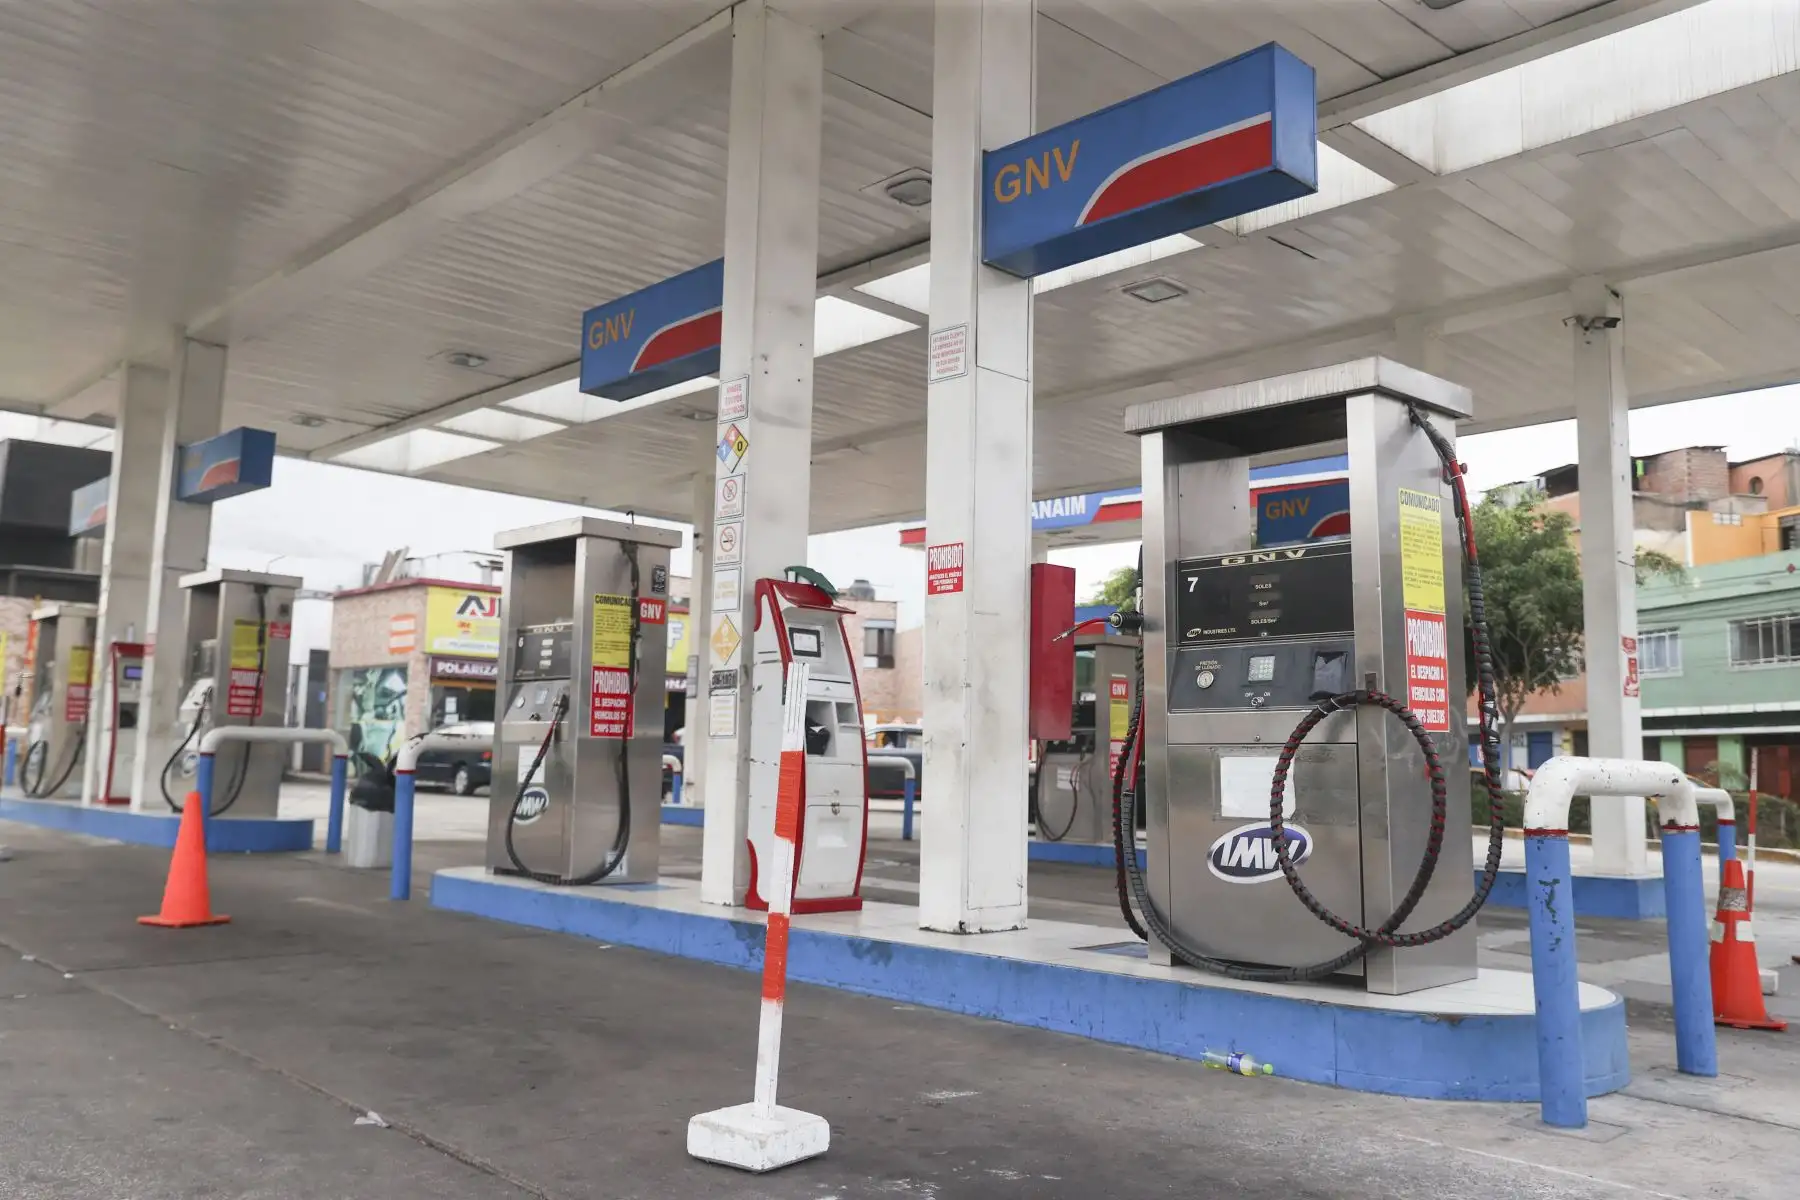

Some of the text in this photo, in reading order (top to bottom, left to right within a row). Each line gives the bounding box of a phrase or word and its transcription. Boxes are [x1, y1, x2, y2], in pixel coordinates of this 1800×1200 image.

[994, 139, 1080, 203] GNV
[589, 308, 635, 350] GNV
[737, 441, 742, 451] 0
[1265, 496, 1310, 520] GNV
[1399, 490, 1440, 513] COMUNICADO
[929, 544, 962, 571] PROHIBIDO
[1221, 549, 1306, 566] GNV
[1187, 576, 1199, 592] 7
[457, 595, 500, 617] AJ
[595, 595, 631, 606] COMUNICA
[640, 602, 662, 620] GNV
[518, 636, 524, 648] 6
[1407, 618, 1445, 659] PROHIBIDO
[1411, 664, 1445, 681] EL DESPACHO A
[1112, 683, 1127, 696] GNV
[1436, 688, 1446, 702] CON
[1427, 709, 1446, 724] SUELTOS
[1220, 837, 1301, 869] IMW
